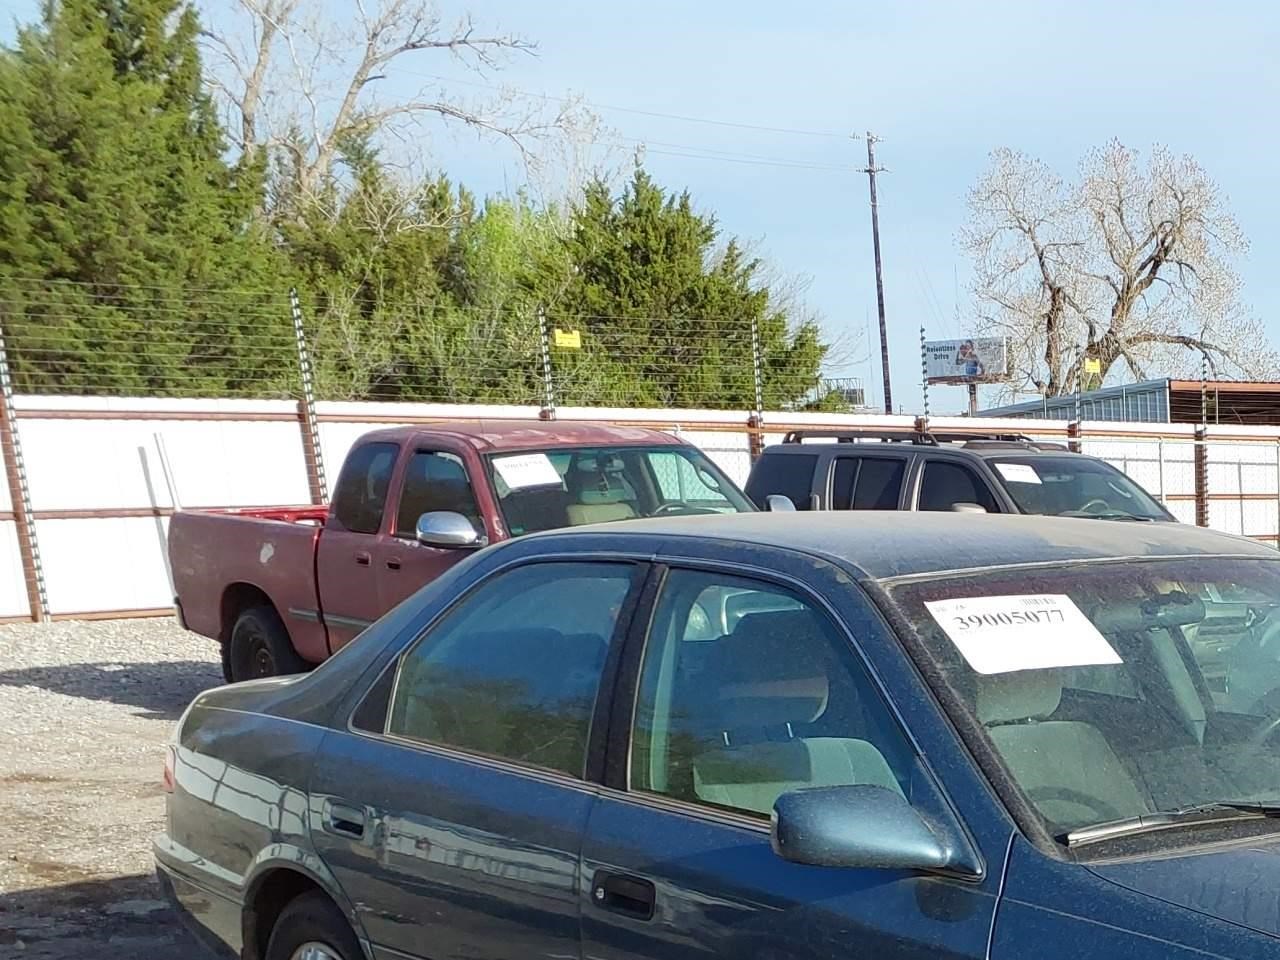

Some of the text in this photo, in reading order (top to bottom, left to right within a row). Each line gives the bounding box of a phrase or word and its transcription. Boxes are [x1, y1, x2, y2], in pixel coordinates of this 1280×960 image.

[926, 345, 956, 353] Relentless
[933, 353, 949, 361] Drive
[953, 609, 1065, 631] 39005077
